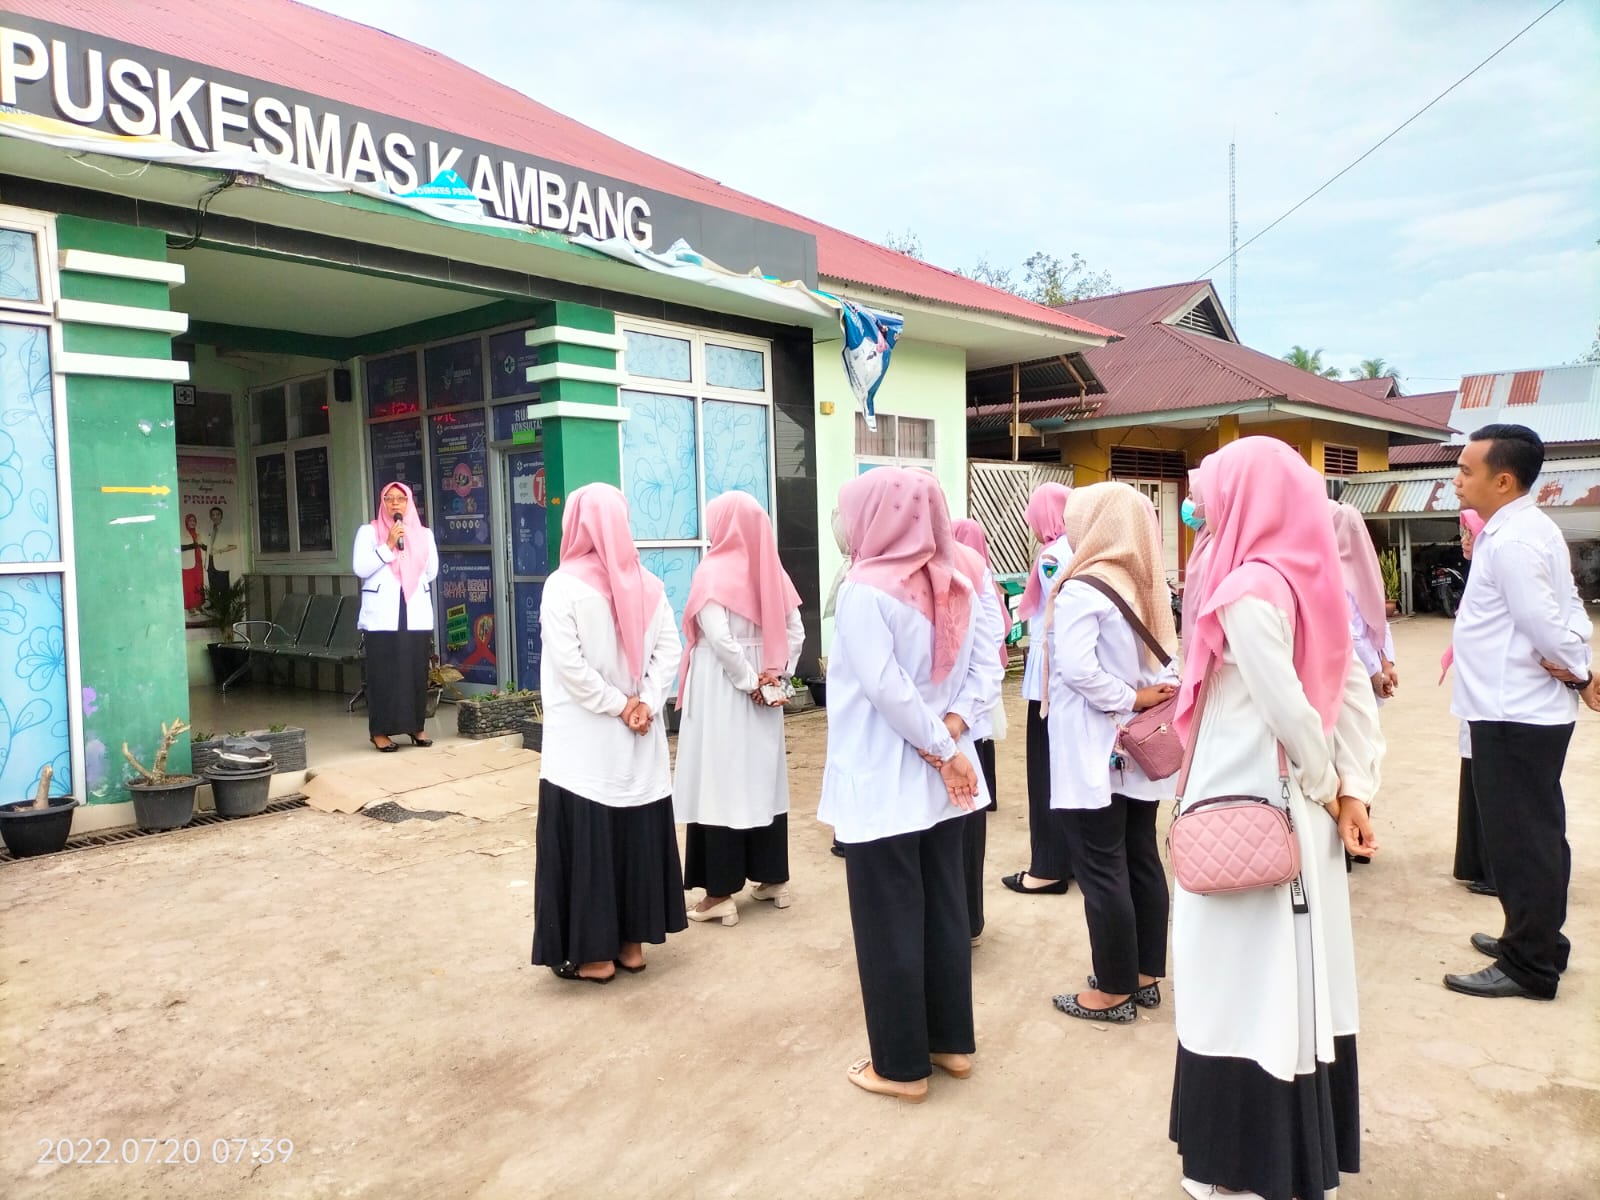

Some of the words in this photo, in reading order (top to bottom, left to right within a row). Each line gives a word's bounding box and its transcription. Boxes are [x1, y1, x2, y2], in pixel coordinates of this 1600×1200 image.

[0, 26, 417, 195] PUSKESMAS
[428, 141, 652, 250] KAMBANG
[183, 494, 228, 505] PRIMA
